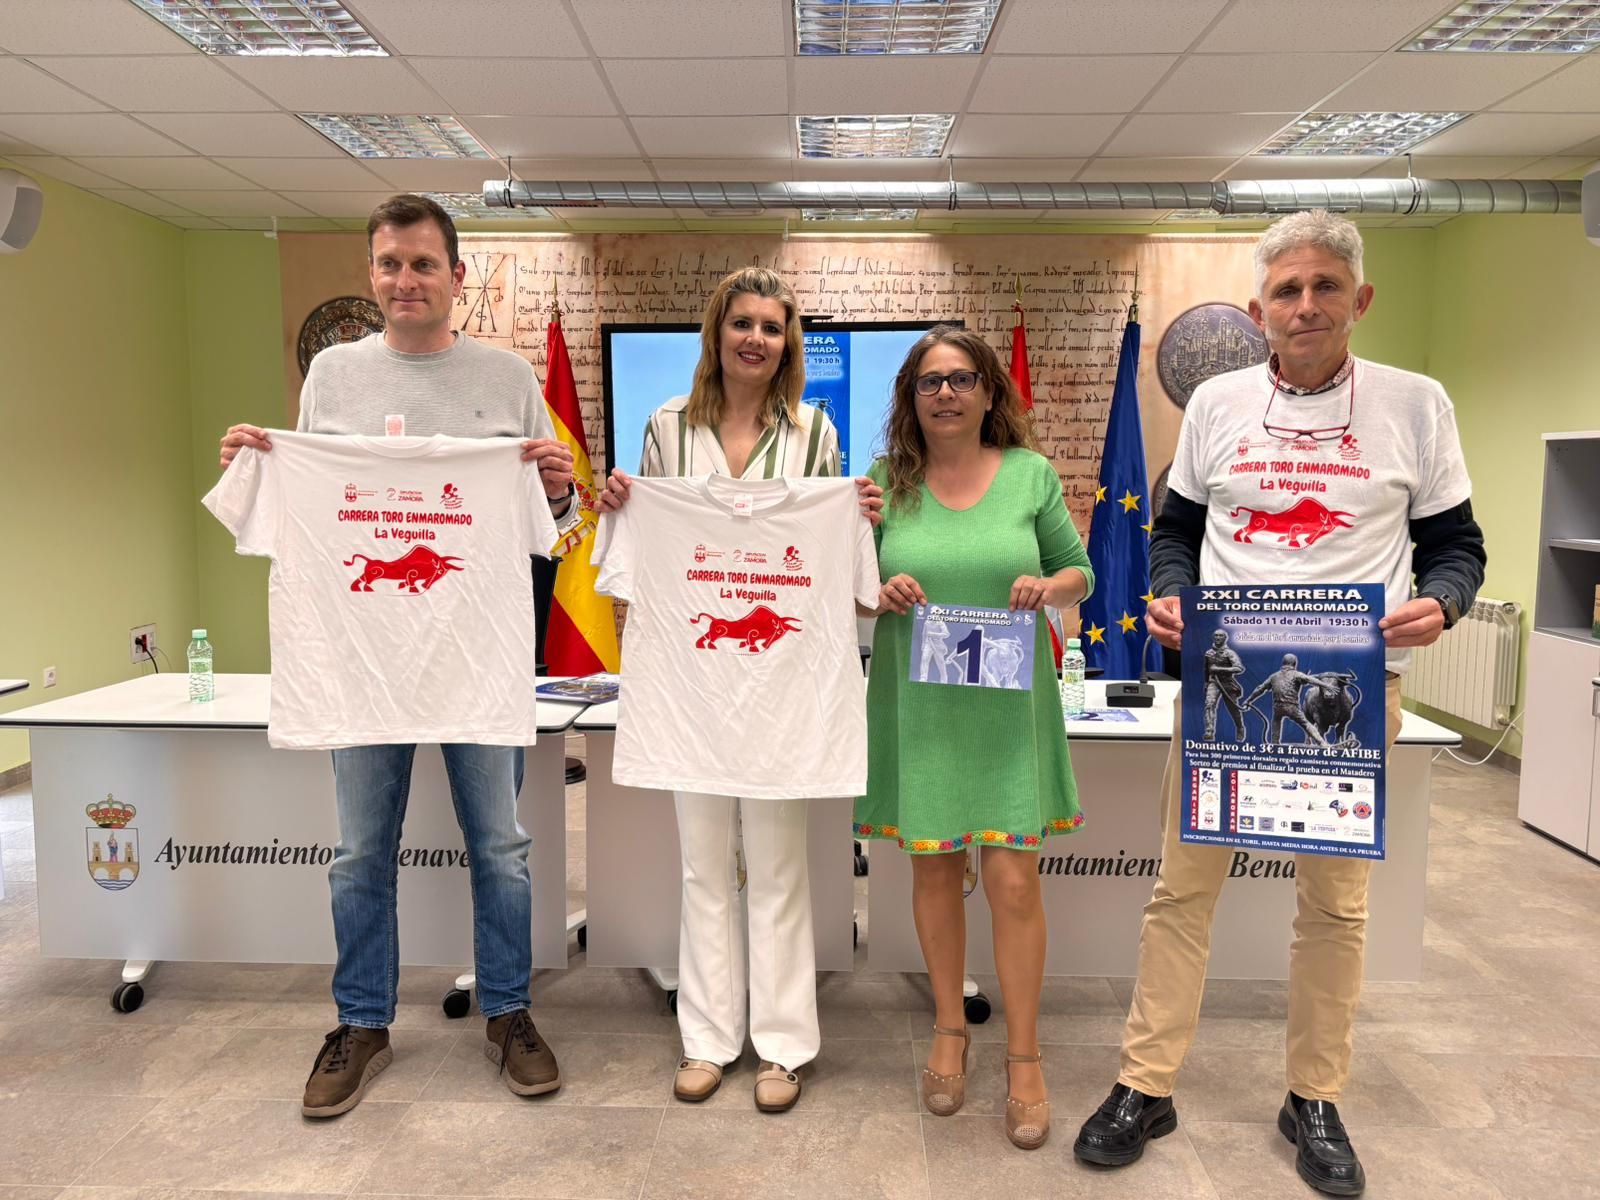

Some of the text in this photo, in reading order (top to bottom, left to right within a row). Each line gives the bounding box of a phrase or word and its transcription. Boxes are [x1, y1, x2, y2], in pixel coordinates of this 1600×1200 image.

[1228, 461, 1371, 480] CARRERA TORO ENMAROMADO
[1260, 478, 1326, 495] La Veguilla
[338, 509, 473, 526] CARRERA TORO ENMAROMADO
[374, 527, 436, 544] La Veguilla
[686, 569, 812, 588] CARRERA TORO ENMAROMADO
[720, 587, 777, 604] La Veguilla
[1200, 588, 1363, 600] XXI CARRERA
[930, 607, 1009, 620] XXI CARRERA
[1196, 602, 1370, 612] DEL TORO ENMAROMADO
[960, 618, 1012, 626] ENMAROMADO
[1223, 616, 1369, 627] Sábado 11 de Abril 19:30 h
[957, 629, 983, 684] 1
[1185, 740, 1381, 760] Donativo de 3€ a favor de AFIBE
[1189, 759, 1211, 767] Sorteo
[1221, 761, 1248, 770] premios
[1249, 762, 1256, 770] al
[1257, 762, 1286, 772] finalizar
[1287, 764, 1294, 772] la
[1296, 766, 1320, 775] prueba
[1332, 767, 1339, 775] el
[1340, 768, 1375, 777] Matadero
[1222, 753, 1250, 761] primeros
[1252, 754, 1278, 762] dorsales
[1279, 756, 1299, 764] regalo
[1300, 758, 1329, 766] camiseta
[1330, 760, 1382, 768] conmemorativa
[1183, 834, 1225, 842] INSCRIPCIONES
[154, 837, 470, 870] Ayuntamiento enave
[1228, 851, 1296, 878] Bena
